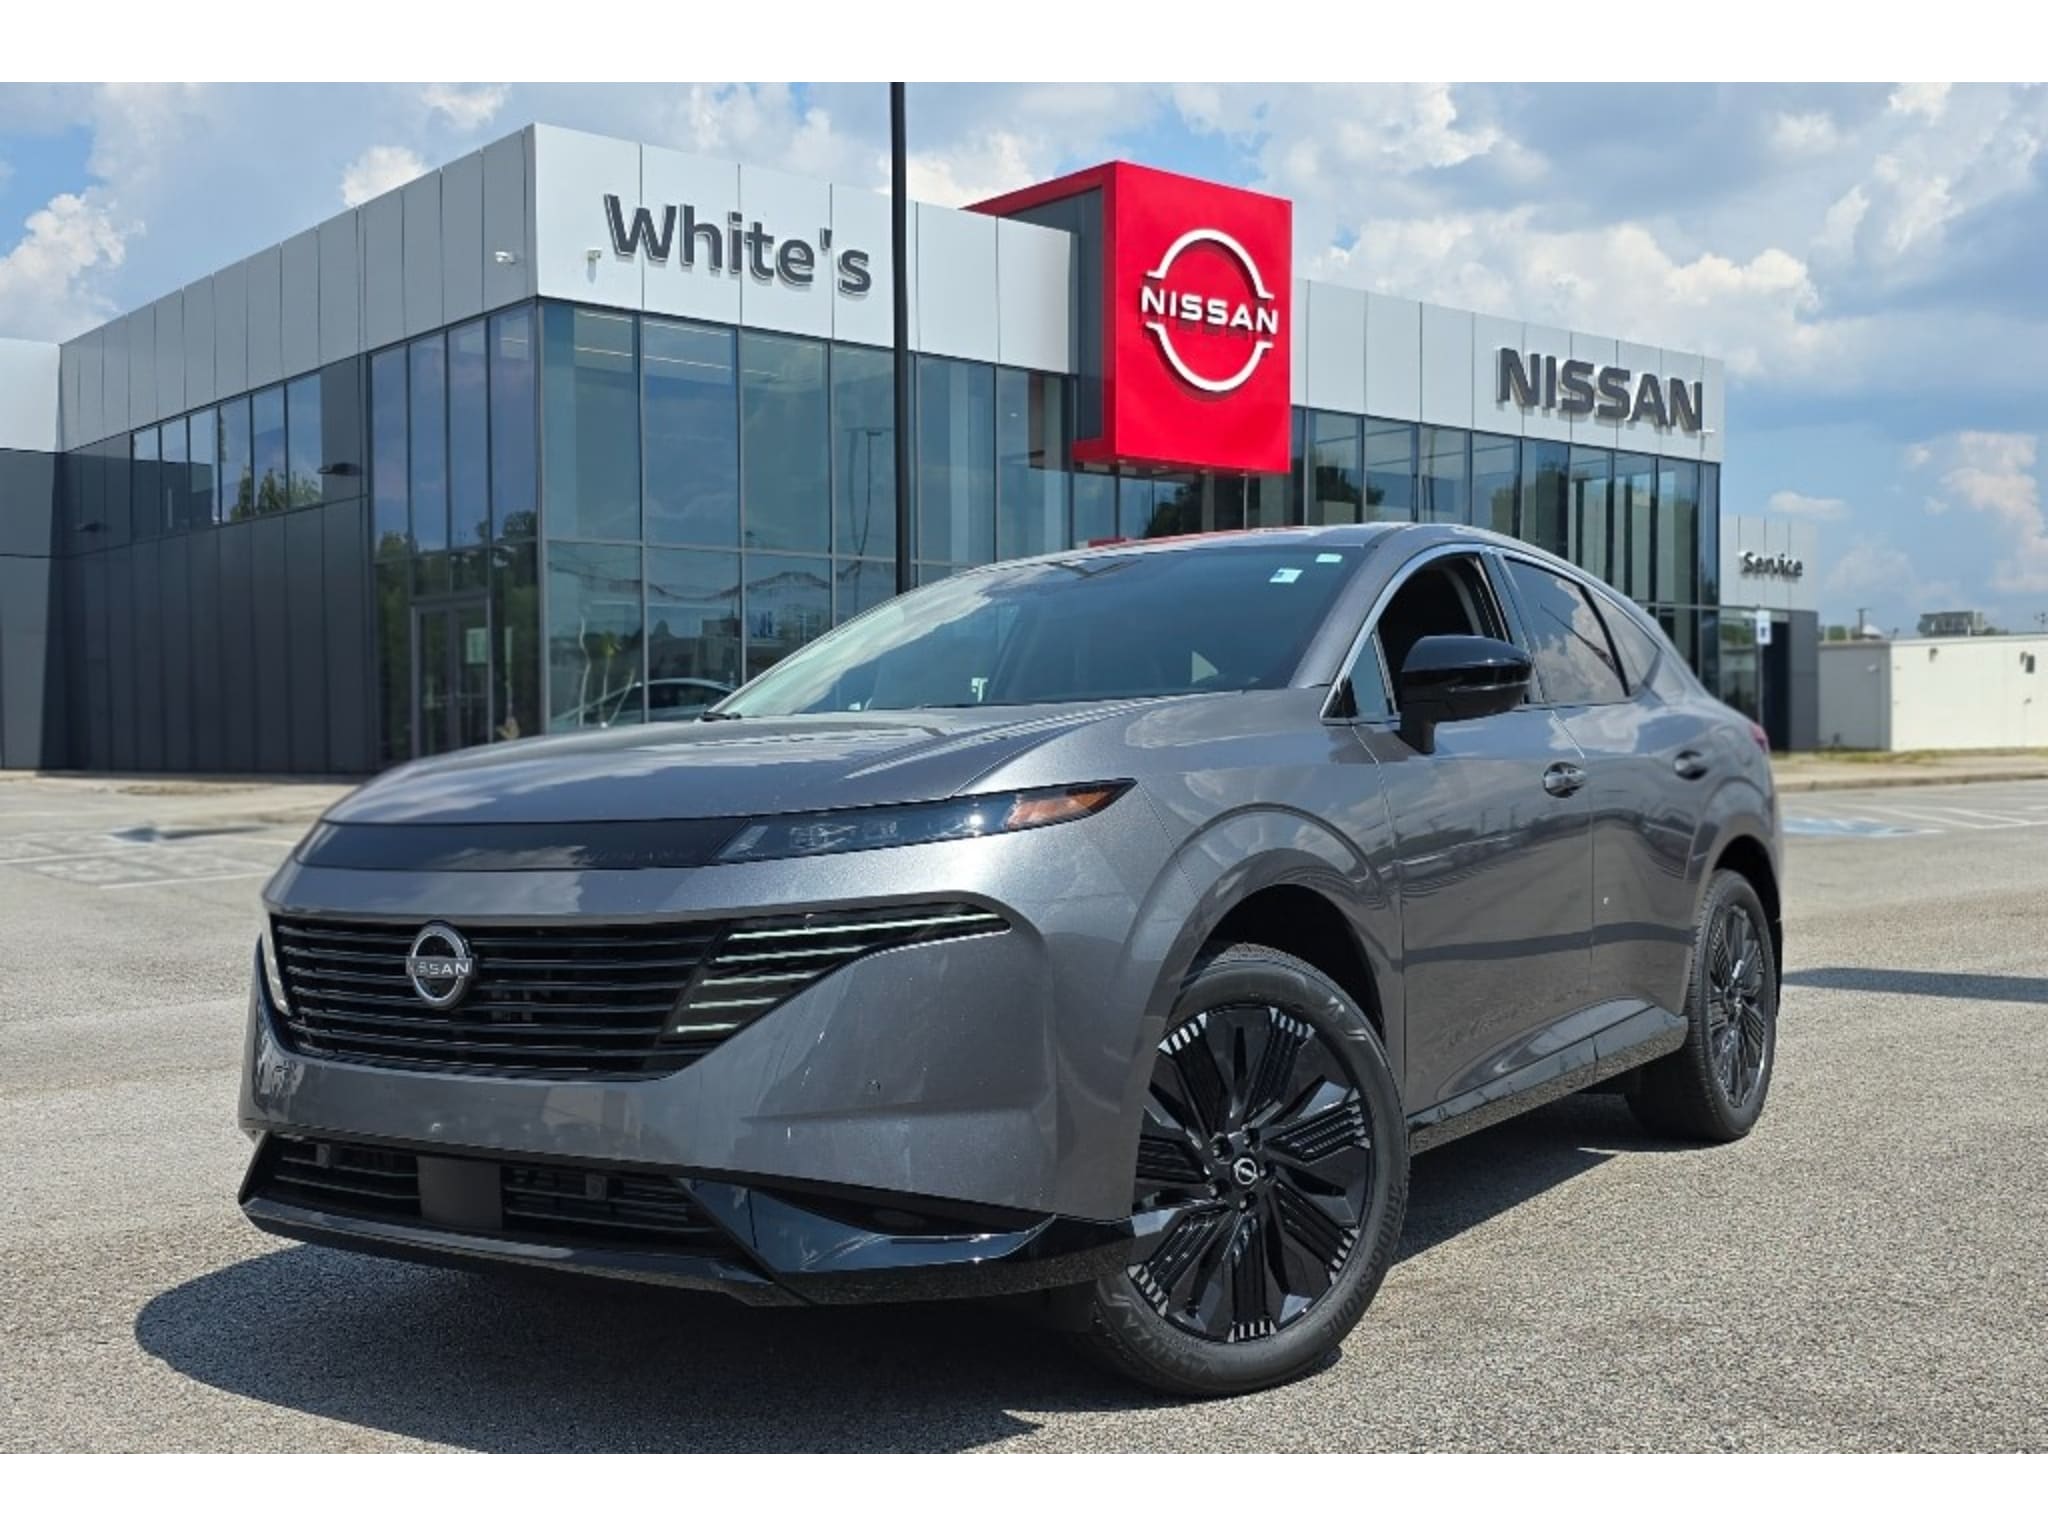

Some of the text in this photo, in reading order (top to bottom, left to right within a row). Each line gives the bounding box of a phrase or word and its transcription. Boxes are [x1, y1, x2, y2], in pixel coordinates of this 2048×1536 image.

[604, 193, 872, 294] White's
[1141, 285, 1278, 335] NISSAN
[1496, 347, 1703, 432] NISSAN
[1740, 551, 1803, 577] Service
